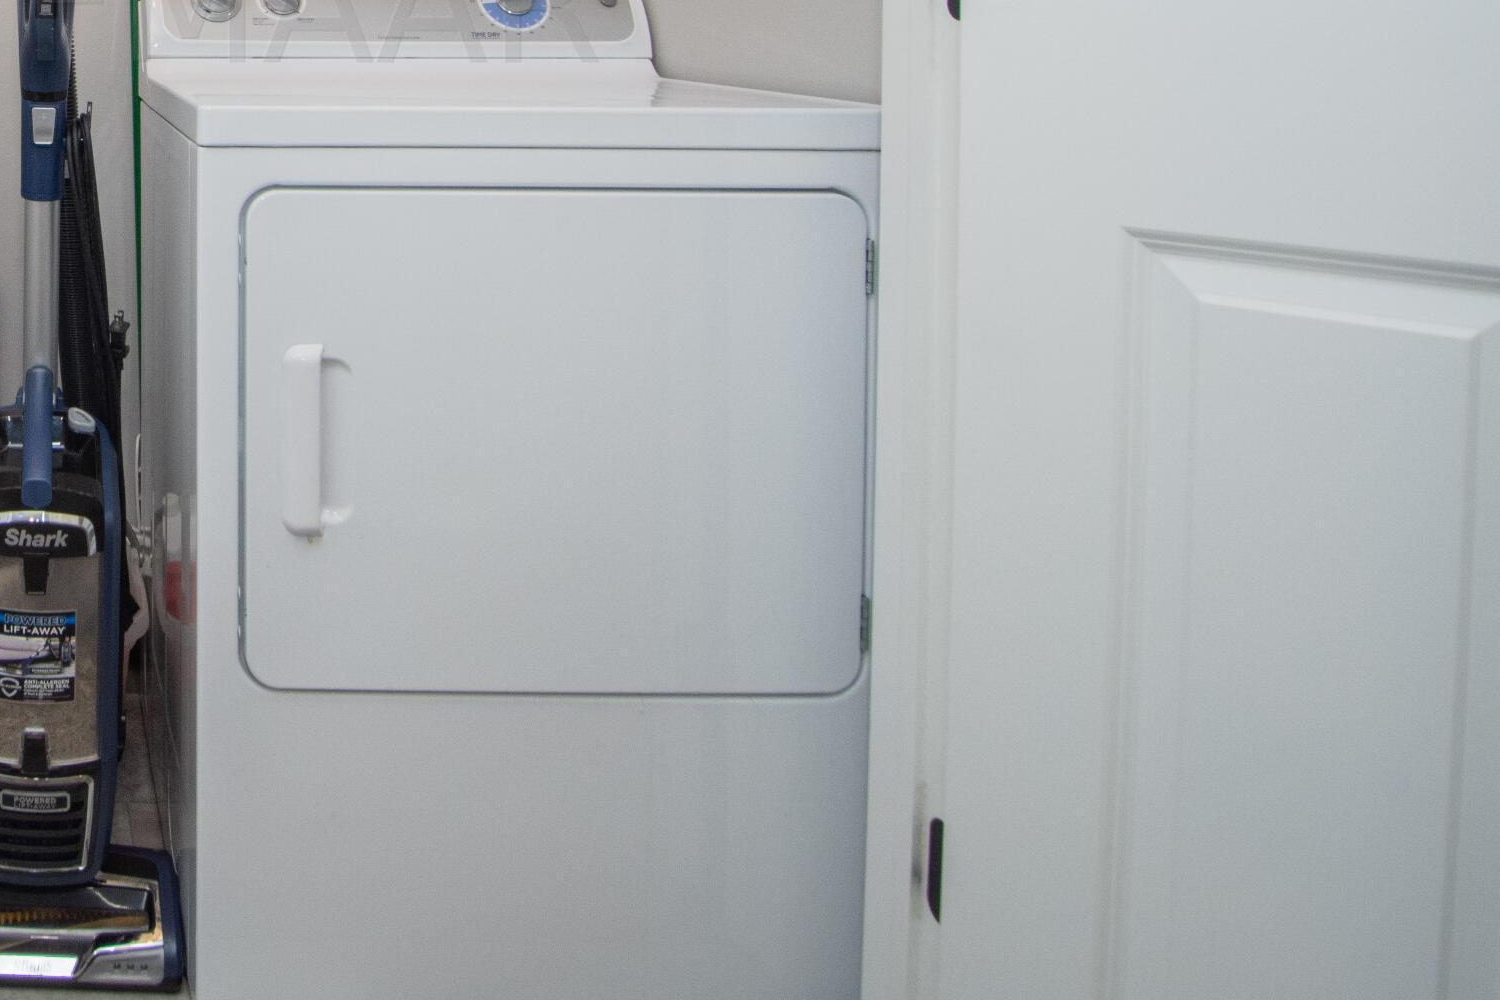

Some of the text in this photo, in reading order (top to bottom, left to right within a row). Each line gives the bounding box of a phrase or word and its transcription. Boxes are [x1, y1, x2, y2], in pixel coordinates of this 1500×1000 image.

[471, 31, 501, 40] TIME DRY
[4, 527, 69, 548] Shark
[4, 613, 66, 627] POWERED
[3, 625, 66, 635] LIFT-AWAY
[14, 795, 57, 804] POWERED
